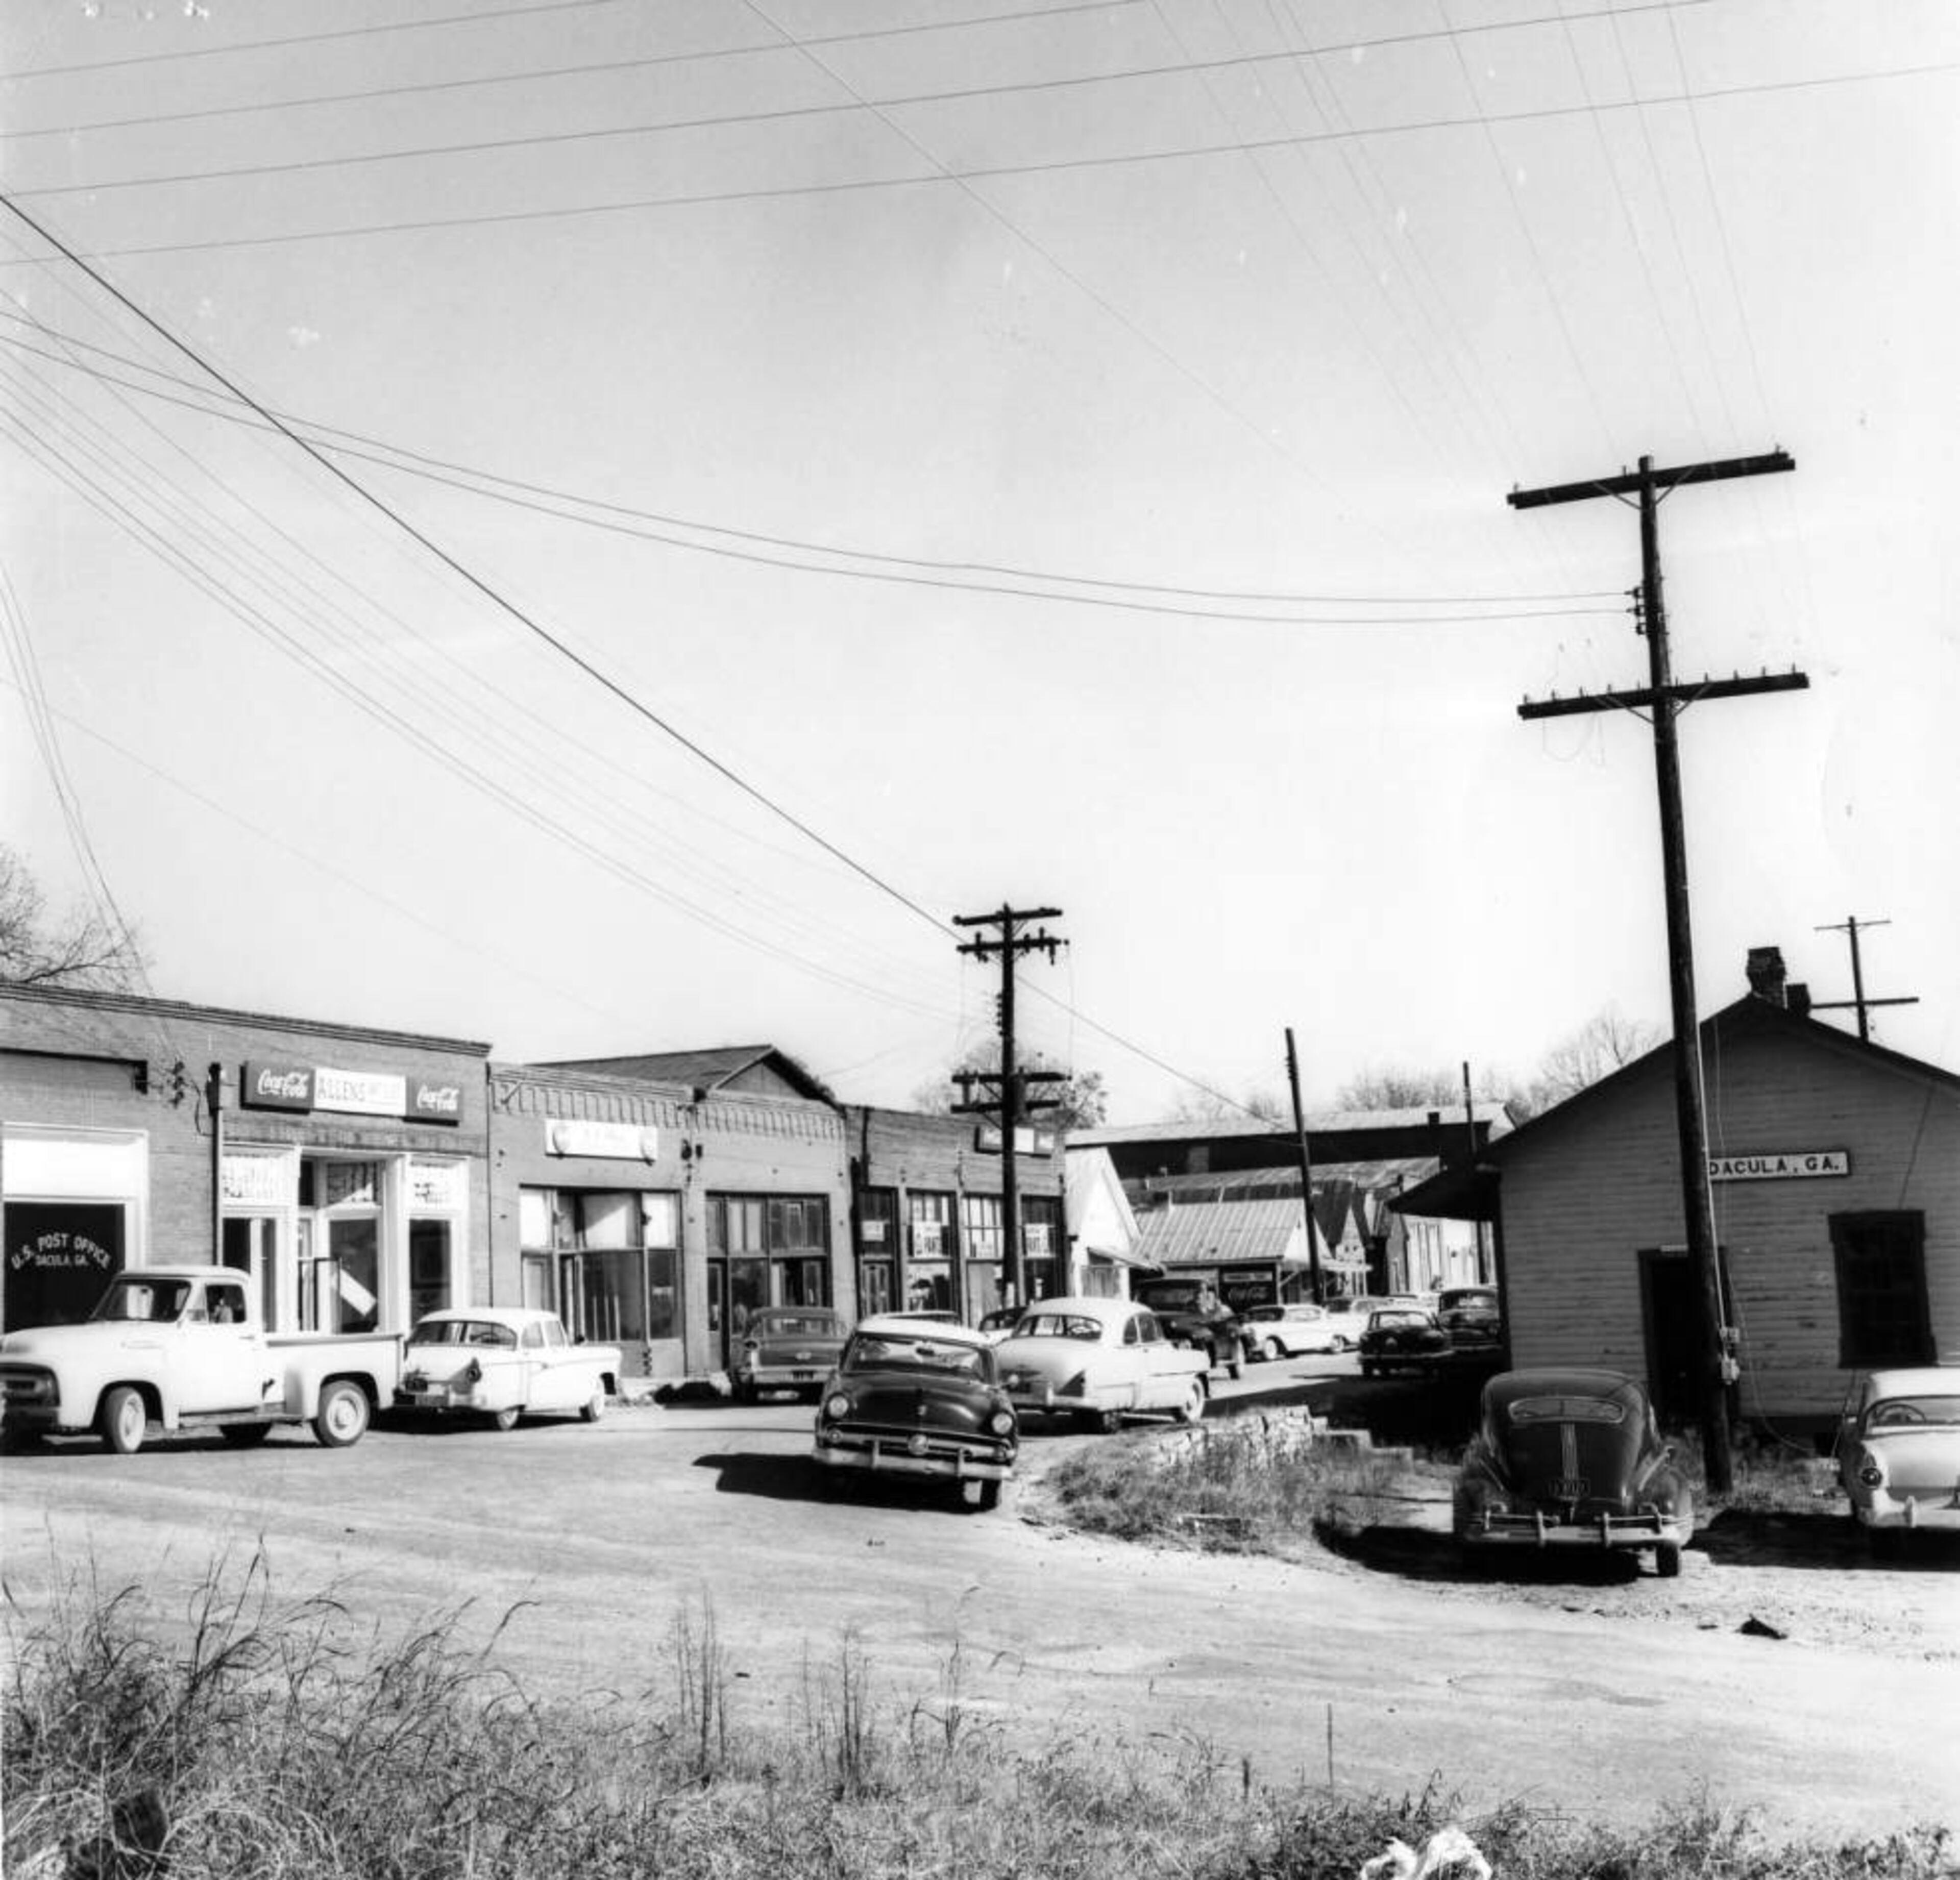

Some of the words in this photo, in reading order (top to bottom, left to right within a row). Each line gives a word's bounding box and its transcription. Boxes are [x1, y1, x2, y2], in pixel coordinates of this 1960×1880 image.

[1805, 1155, 1840, 1171] GA.
[37, 1232, 69, 1252] POST
[74, 1235, 110, 1269] OFFICE
